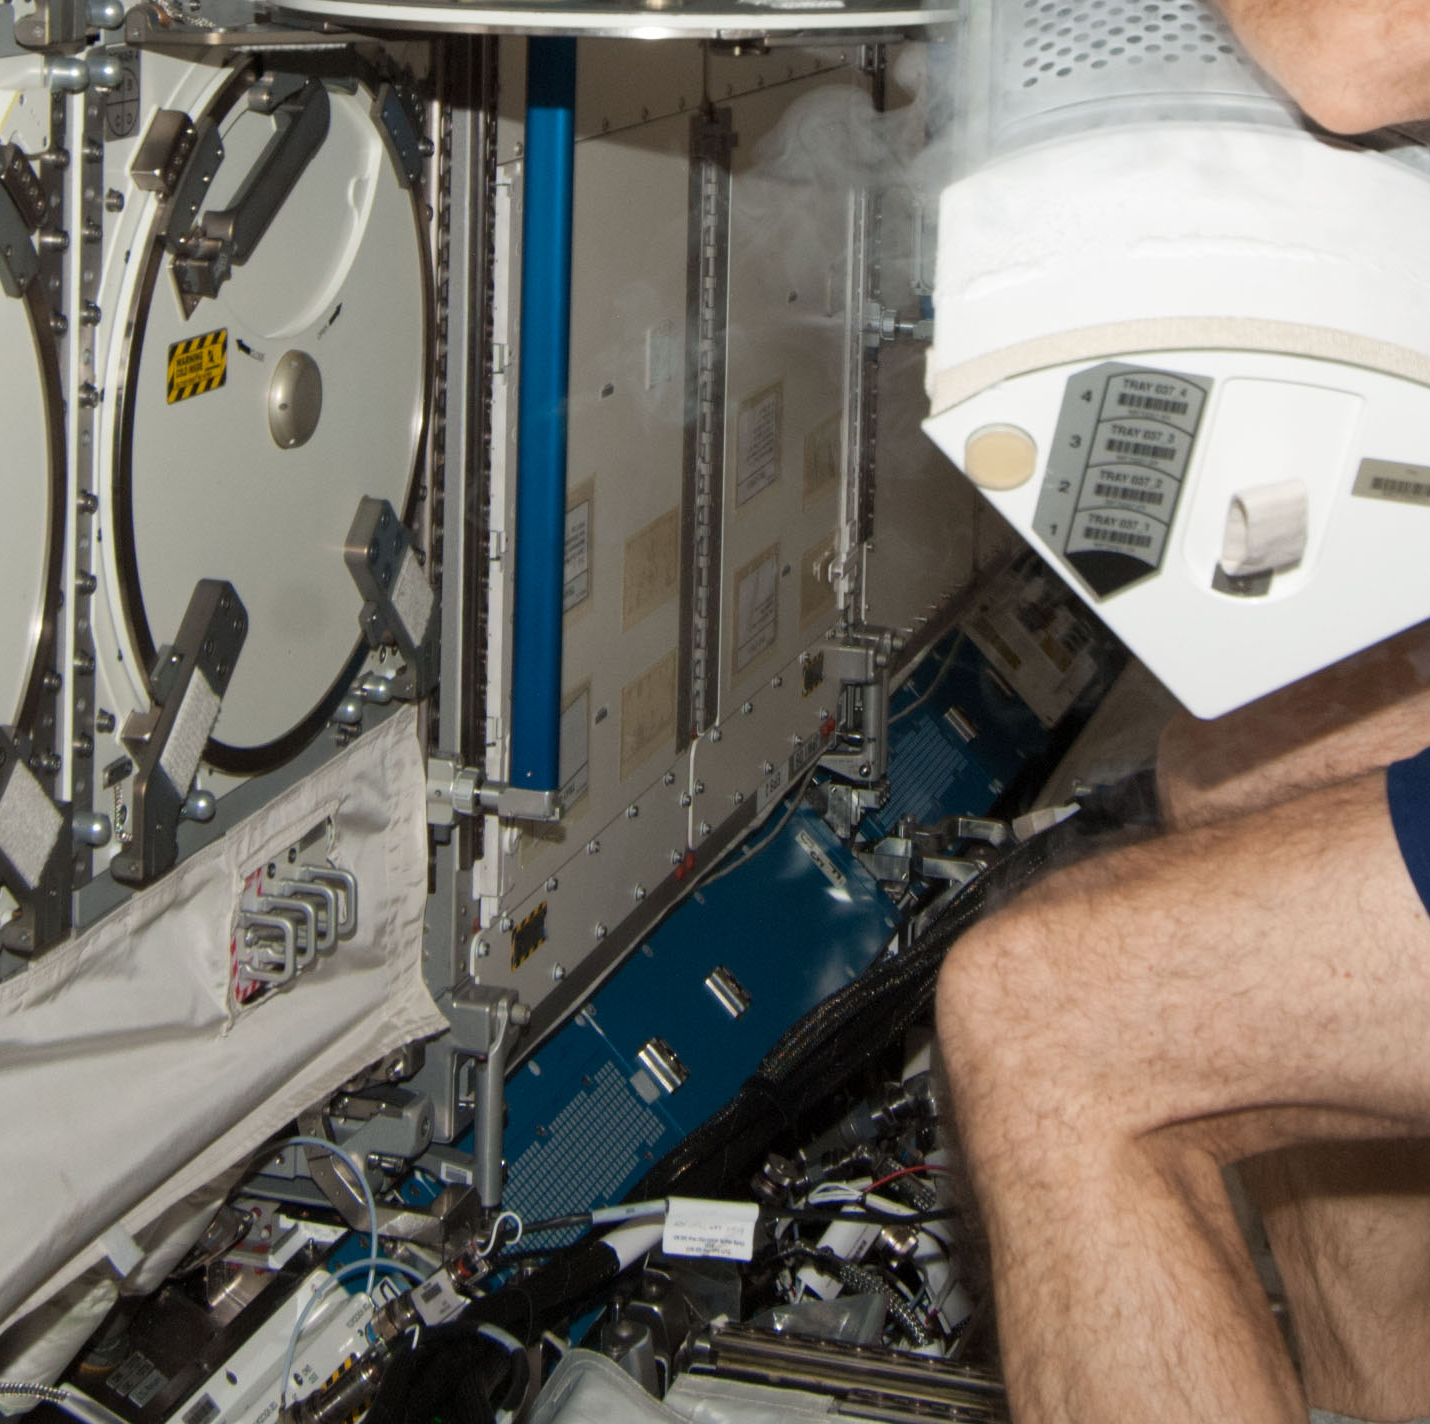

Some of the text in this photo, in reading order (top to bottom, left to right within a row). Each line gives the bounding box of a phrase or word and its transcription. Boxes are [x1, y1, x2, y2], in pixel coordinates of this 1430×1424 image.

[175, 350, 204, 366] WARNING
[1122, 378, 1154, 393] TRAY
[1081, 389, 1093, 403] 4
[1111, 424, 1142, 439] TRAY
[1069, 435, 1082, 450] 3
[1100, 469, 1130, 484] TRAY
[1058, 481, 1071, 494] 2
[1088, 513, 1118, 527] TRAY
[1049, 524, 1058, 536] 1
